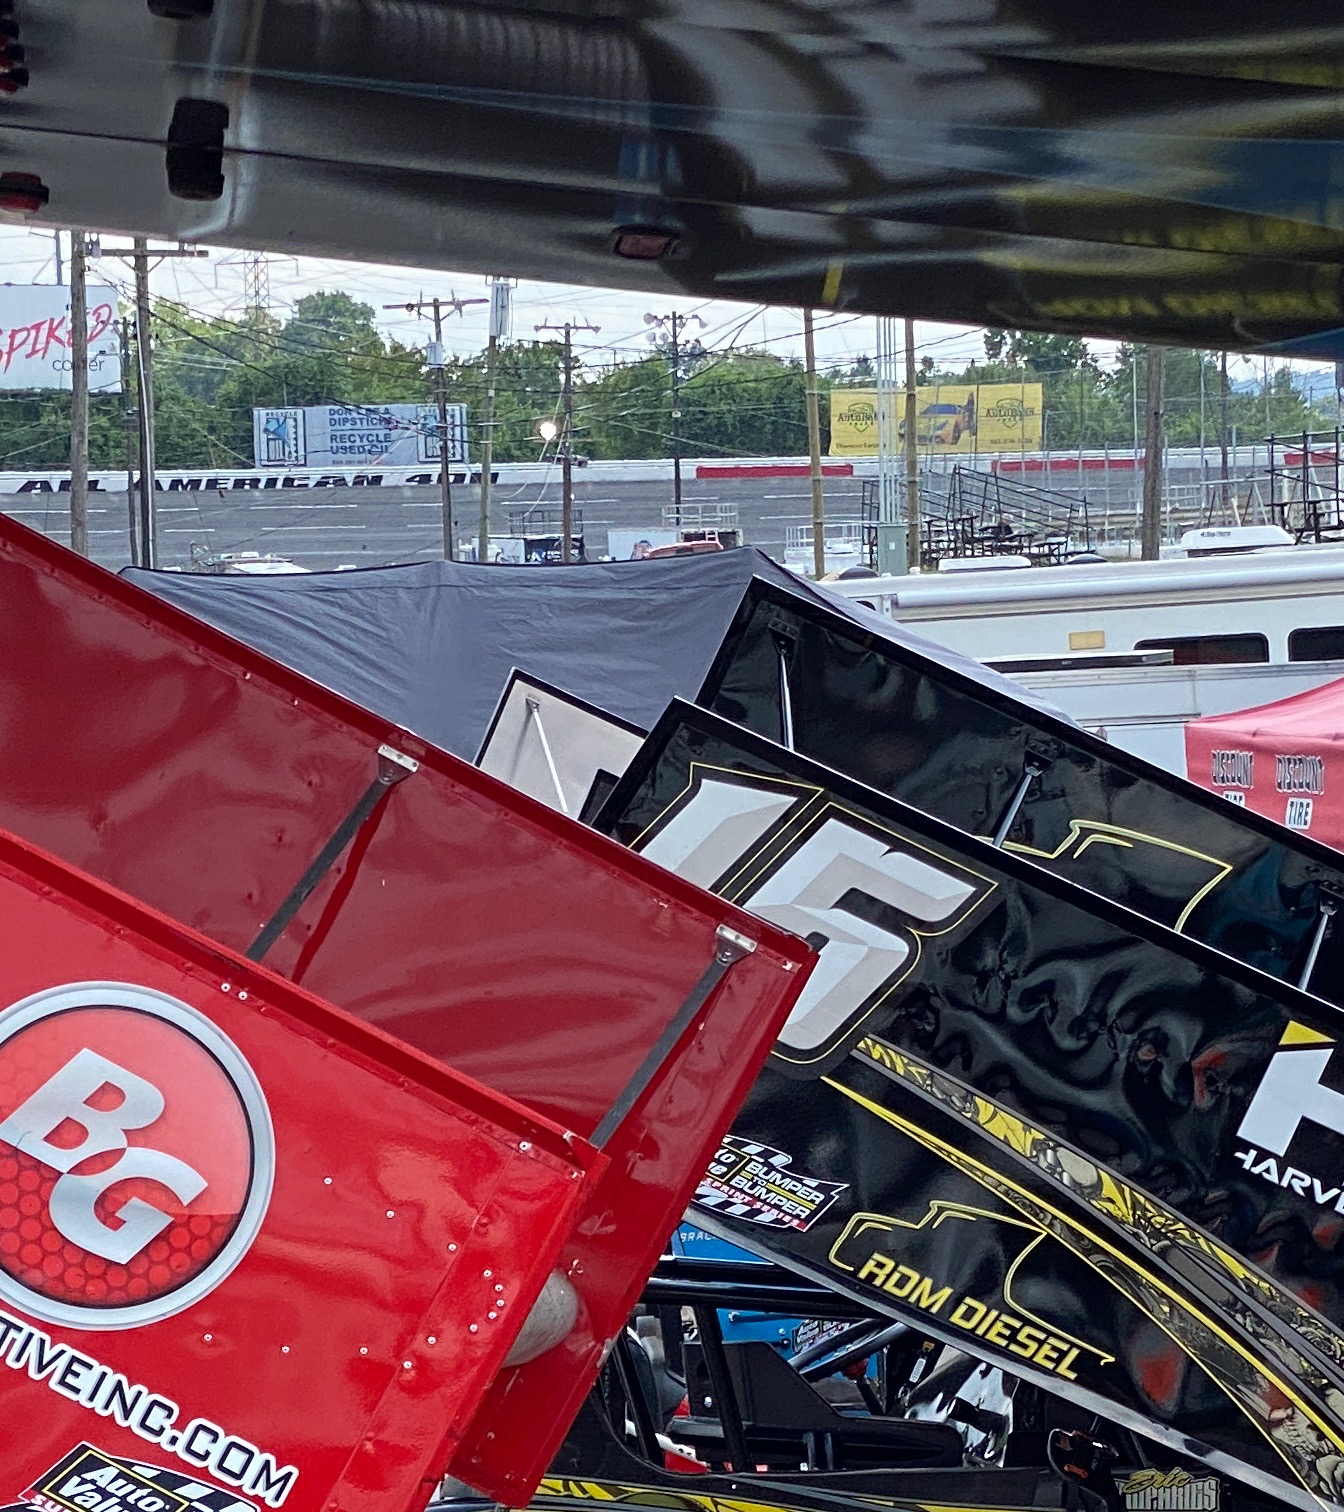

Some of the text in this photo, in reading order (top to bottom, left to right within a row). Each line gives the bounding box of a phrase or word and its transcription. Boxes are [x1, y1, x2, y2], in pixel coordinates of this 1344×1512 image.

[52, 360, 105, 372] coer
[329, 433, 392, 443] RECYCLE
[1289, 801, 1311, 826] TIRE
[729, 1175, 811, 1219] BUMPER
[743, 1160, 825, 1204] BUMPER
[752, 1175, 766, 1187] TO
[705, 1178, 800, 1227] SPRINT SERIES
[857, 1251, 1082, 1381] RDM DIESEL
